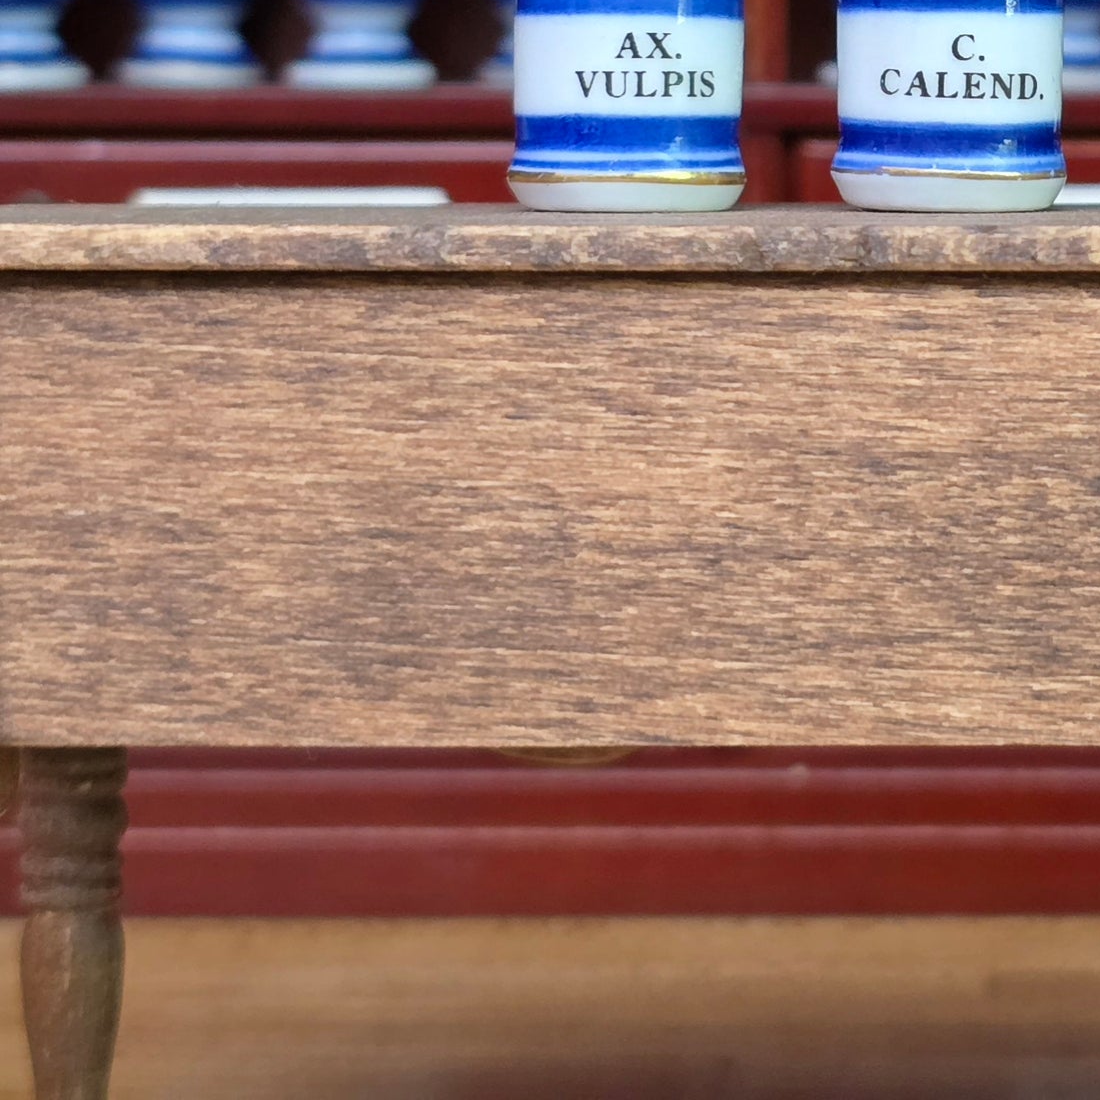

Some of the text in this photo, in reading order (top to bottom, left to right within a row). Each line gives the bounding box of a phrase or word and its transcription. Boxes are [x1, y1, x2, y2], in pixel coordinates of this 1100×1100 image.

[616, 32, 682, 59] AX.
[951, 34, 985, 62] C.
[575, 70, 715, 98] VULPIS
[880, 68, 1045, 100] CALEND.
